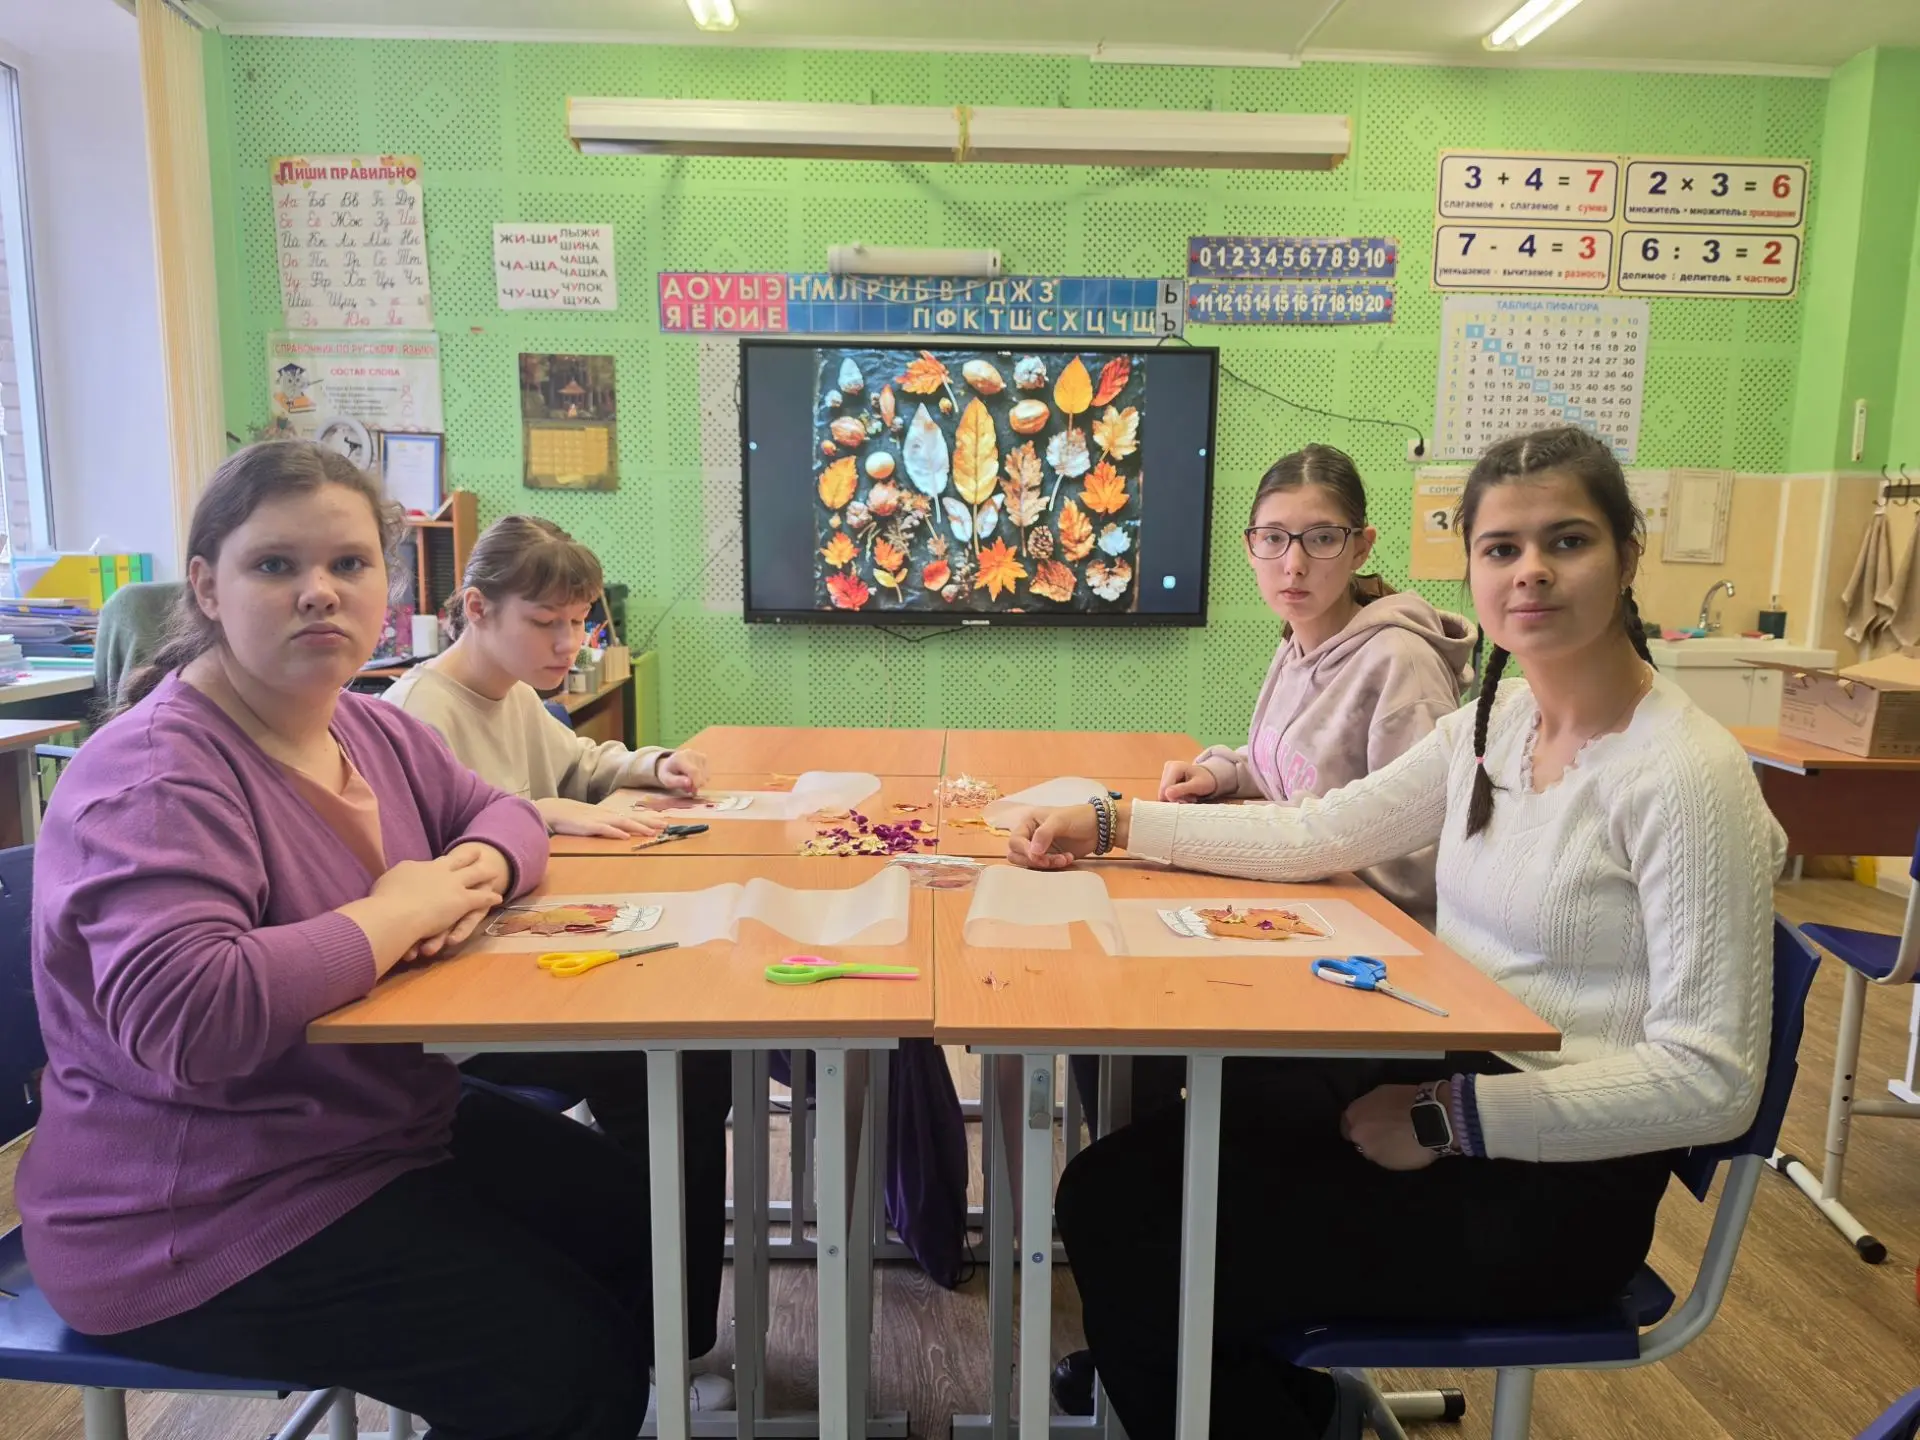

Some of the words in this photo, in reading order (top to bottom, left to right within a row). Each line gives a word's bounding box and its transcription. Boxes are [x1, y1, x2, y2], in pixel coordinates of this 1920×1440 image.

[1465, 165, 1482, 189] 3
[1525, 167, 1544, 191] 4
[1587, 169, 1604, 193] 7
[1648, 171, 1668, 195] 2
[1711, 172, 1729, 196] 3
[1772, 174, 1791, 198] 6
[1444, 201, 1494, 210] слагаемое
[1510, 202, 1559, 211] слагаемое
[1578, 204, 1608, 213] сумма
[1628, 205, 1680, 214] множитель
[500, 233, 558, 244] ЖИ-ШИ
[560, 241, 600, 250] ШИНА
[1459, 233, 1476, 256] 7
[1518, 234, 1537, 258] 4
[1579, 236, 1597, 260] 3
[1641, 238, 1659, 261] 6
[1702, 239, 1720, 263] 3
[1762, 240, 1782, 265] 2
[560, 255, 599, 265] ЧАЩА
[1200, 248, 1210, 267] 0
[1217, 248, 1226, 267] 1
[1232, 248, 1244, 267] 2
[1250, 248, 1260, 267] 3
[1265, 248, 1277, 267] 4
[1283, 248, 1294, 268] 5
[1300, 249, 1311, 268] 6
[1316, 249, 1327, 268] 7
[1332, 249, 1343, 268] 8
[1348, 249, 1360, 268] 9
[1364, 249, 1386, 268] 10
[500, 260, 558, 272] ЧА-ЩА
[560, 268, 608, 278] ЧАШКА
[1502, 268, 1553, 278] вычитаемое
[1564, 270, 1606, 281] разность
[1622, 271, 1667, 281] делимое
[1680, 273, 1731, 283] делитель
[1744, 275, 1788, 284] частное
[502, 288, 560, 299] ЧУ-ЩУ
[563, 295, 600, 305] ЩУКА
[1198, 294, 1213, 312] 11
[1216, 295, 1232, 312] 12
[1235, 295, 1252, 312] 13
[1254, 295, 1270, 312] 14
[1273, 295, 1289, 312] 15
[1292, 295, 1308, 312] 16
[1310, 295, 1328, 312] 17
[1330, 295, 1346, 312] 18
[1347, 295, 1364, 312] 19
[1366, 295, 1385, 312] 20
[1490, 328, 1496, 336] 2
[1508, 328, 1514, 336] 3
[1560, 329, 1566, 337] 6
[1626, 331, 1637, 339] 10
[1471, 341, 1478, 349] 2
[1540, 342, 1551, 350] 10
[1608, 344, 1619, 352] 18
[1572, 356, 1583, 364] 21
[1605, 357, 1618, 365] 27
